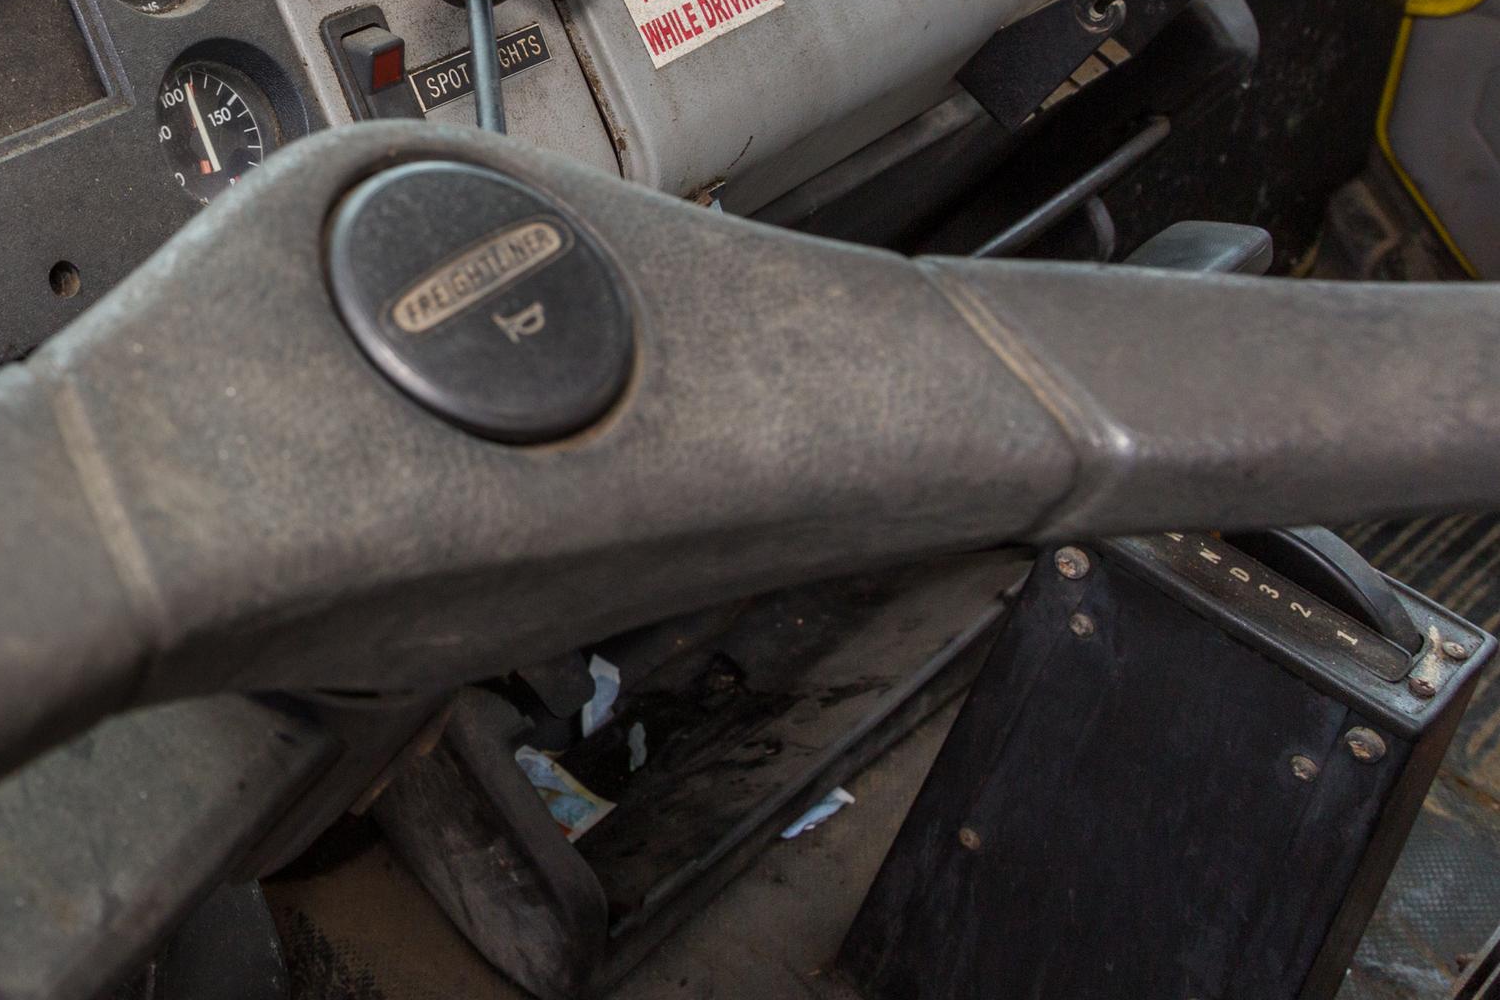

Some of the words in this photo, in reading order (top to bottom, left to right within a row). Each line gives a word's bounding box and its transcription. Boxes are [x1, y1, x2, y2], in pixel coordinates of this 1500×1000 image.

[640, 2, 704, 56] WHILE
[426, 62, 470, 98] SPOT
[498, 35, 541, 68] GHTS
[161, 88, 184, 109] 100
[207, 107, 231, 127] 150
[159, 125, 172, 143] 0
[404, 229, 555, 325] FREGHTLNER
[1200, 547, 1222, 565] N
[1229, 566, 1250, 583] D
[1259, 584, 1280, 600] 3
[1290, 602, 1312, 619] 2
[1337, 629, 1358, 646] 1
